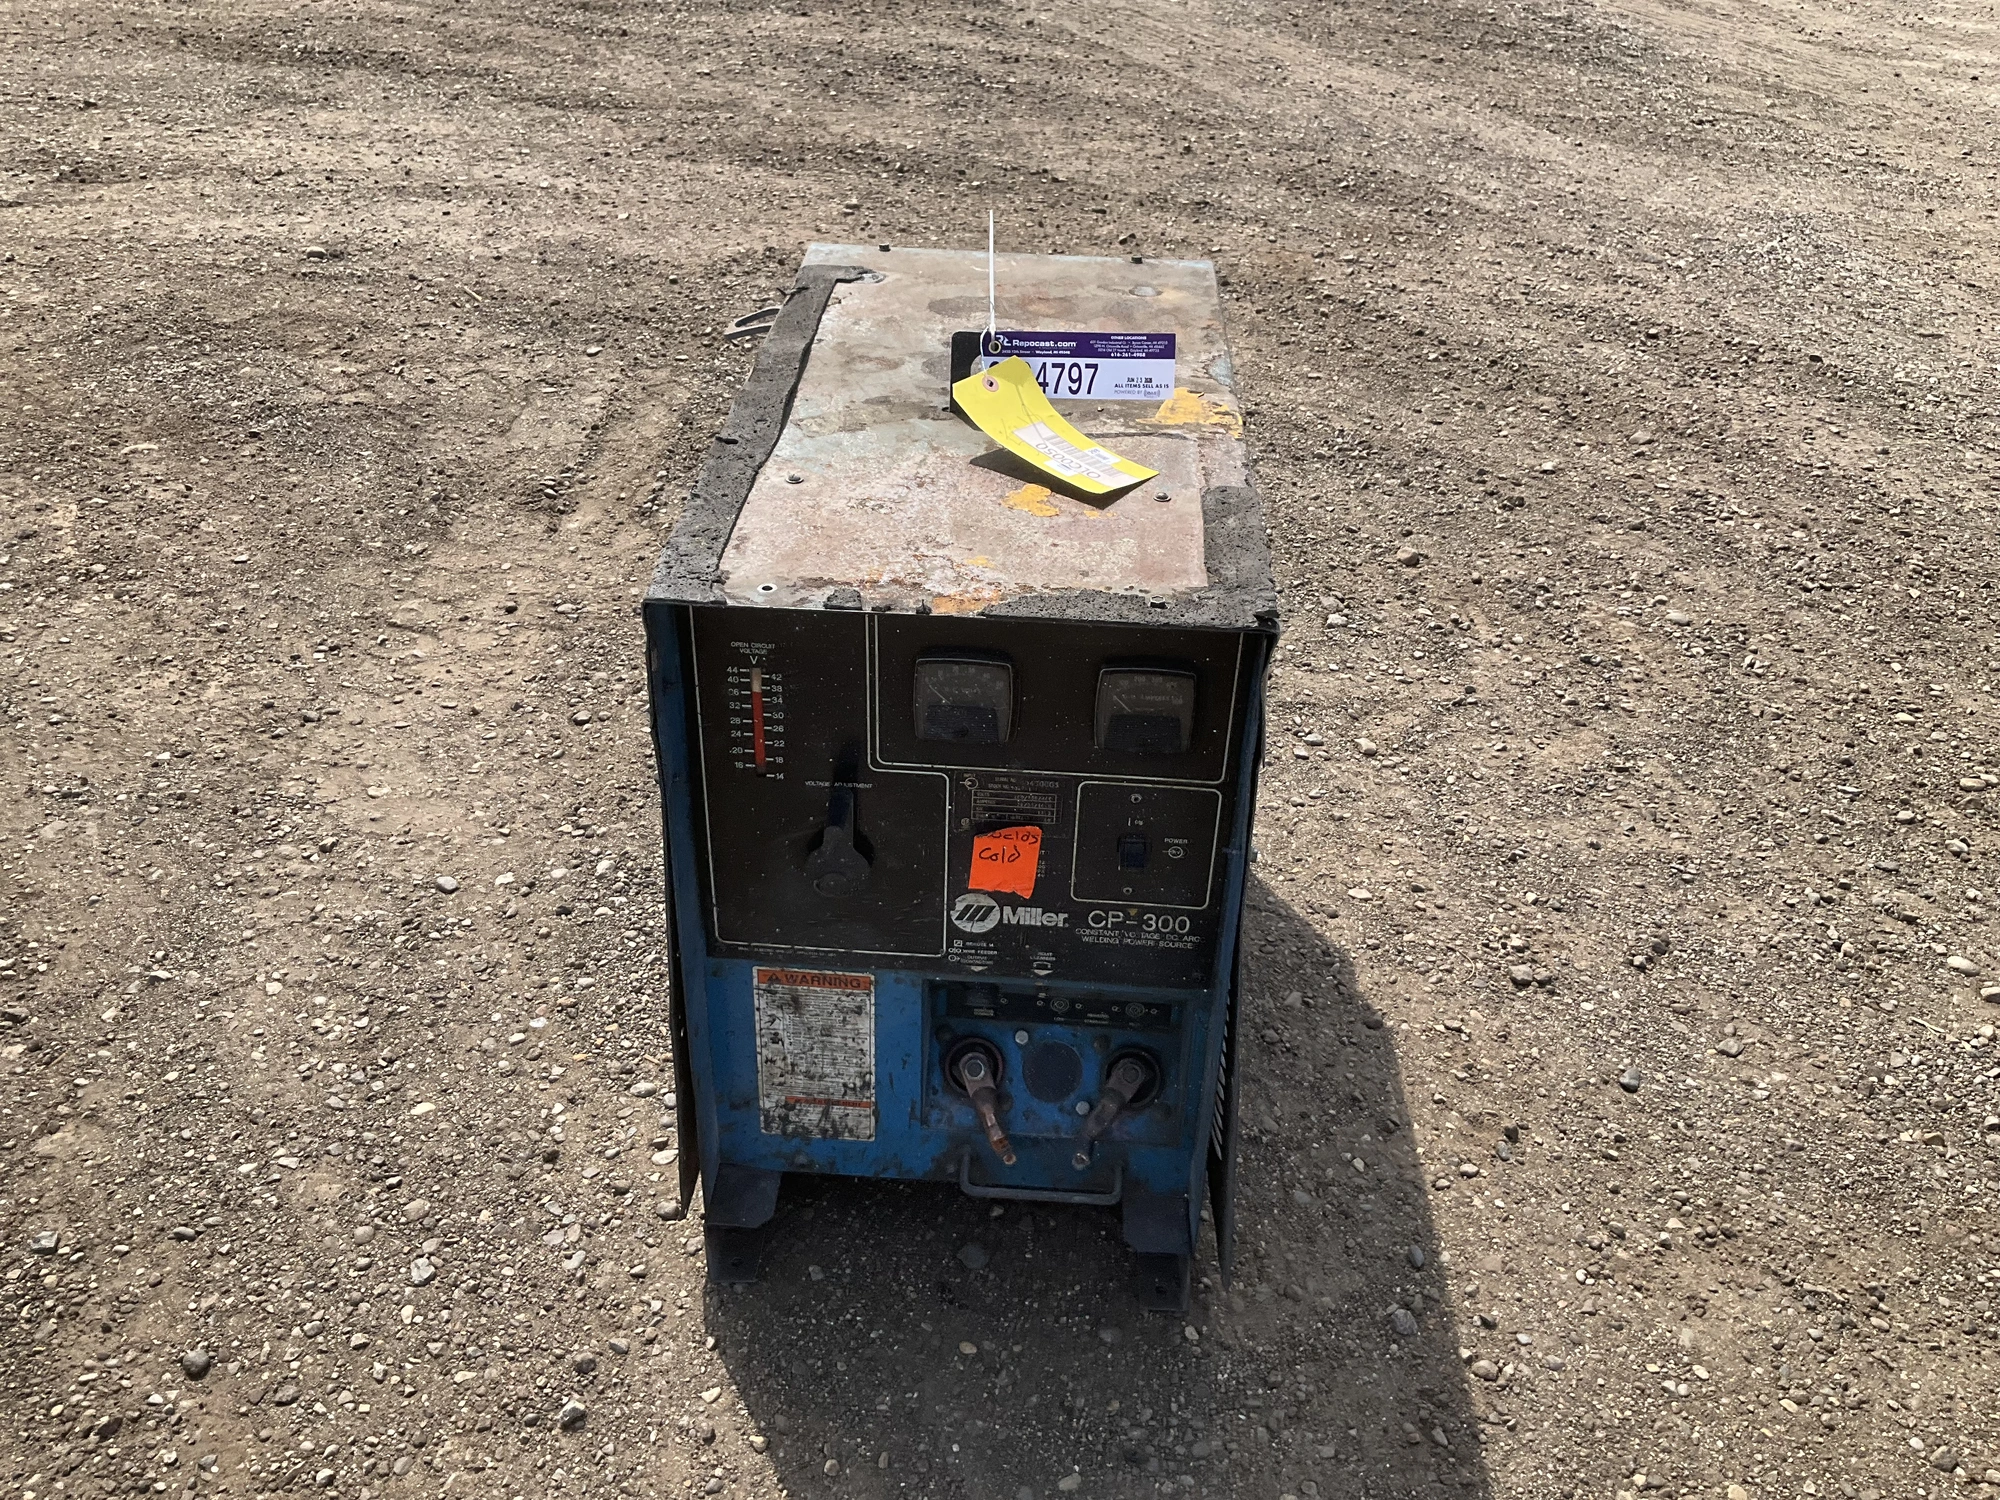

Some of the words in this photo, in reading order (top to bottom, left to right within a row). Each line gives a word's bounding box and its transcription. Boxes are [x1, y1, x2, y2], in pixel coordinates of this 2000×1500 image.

[750, 656, 758, 664] V
[978, 844, 1020, 863] Cold
[1002, 906, 1068, 927] Miller
[1088, 910, 1190, 933] CP-300
[1076, 928, 1119, 936] CONSTANT
[1082, 936, 1119, 944] WELDING
[785, 974, 861, 988] WARNING
